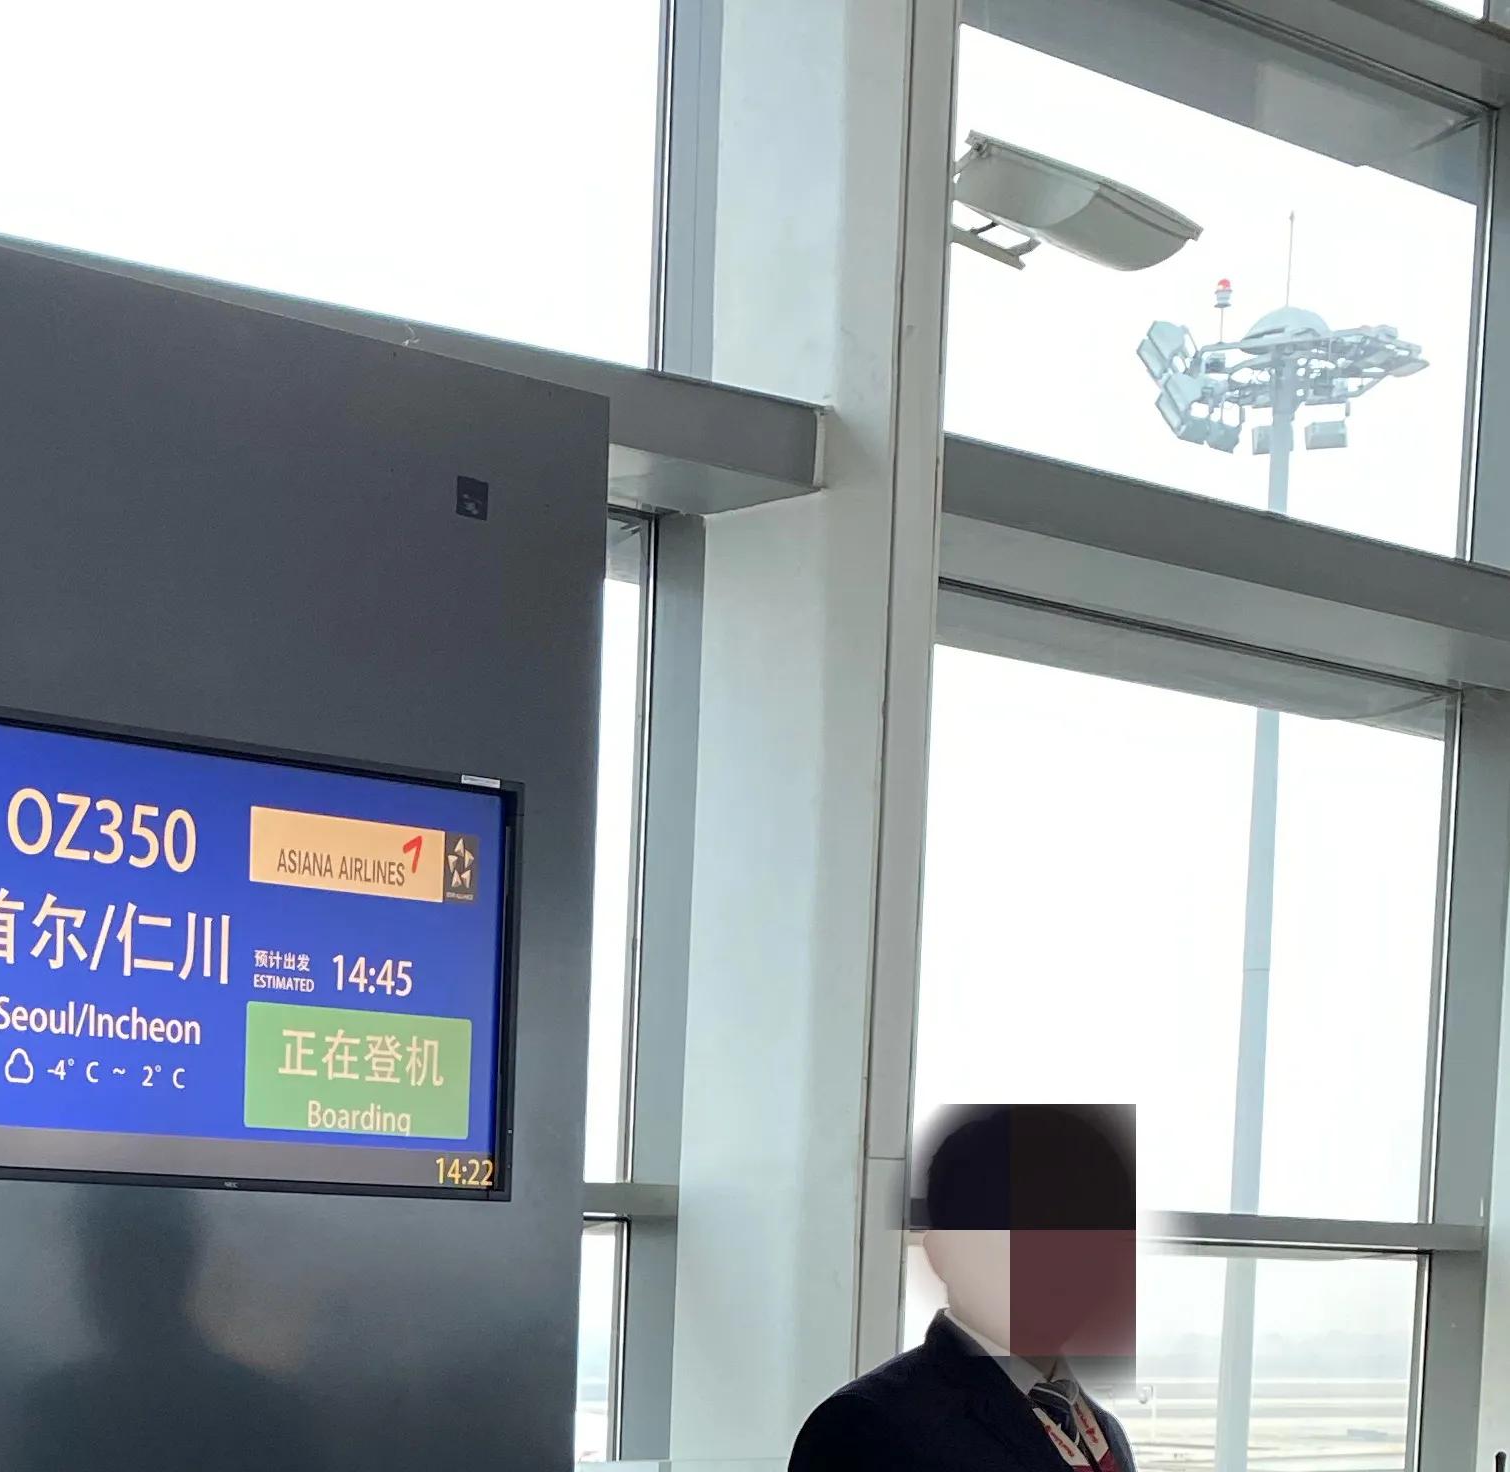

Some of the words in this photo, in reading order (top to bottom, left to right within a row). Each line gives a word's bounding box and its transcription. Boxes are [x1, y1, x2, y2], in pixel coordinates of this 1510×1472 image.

[7, 787, 197, 874] OZ350
[276, 847, 334, 879] ASIANA
[338, 856, 406, 888] AIRLINES
[253, 949, 311, 973] 预计出发
[331, 954, 414, 998] 14:45
[253, 973, 316, 993] ESTIMATED
[278, 1027, 445, 1088] 正在登机
[306, 1099, 412, 1137] Boarding
[435, 1157, 494, 1187] 14:22
